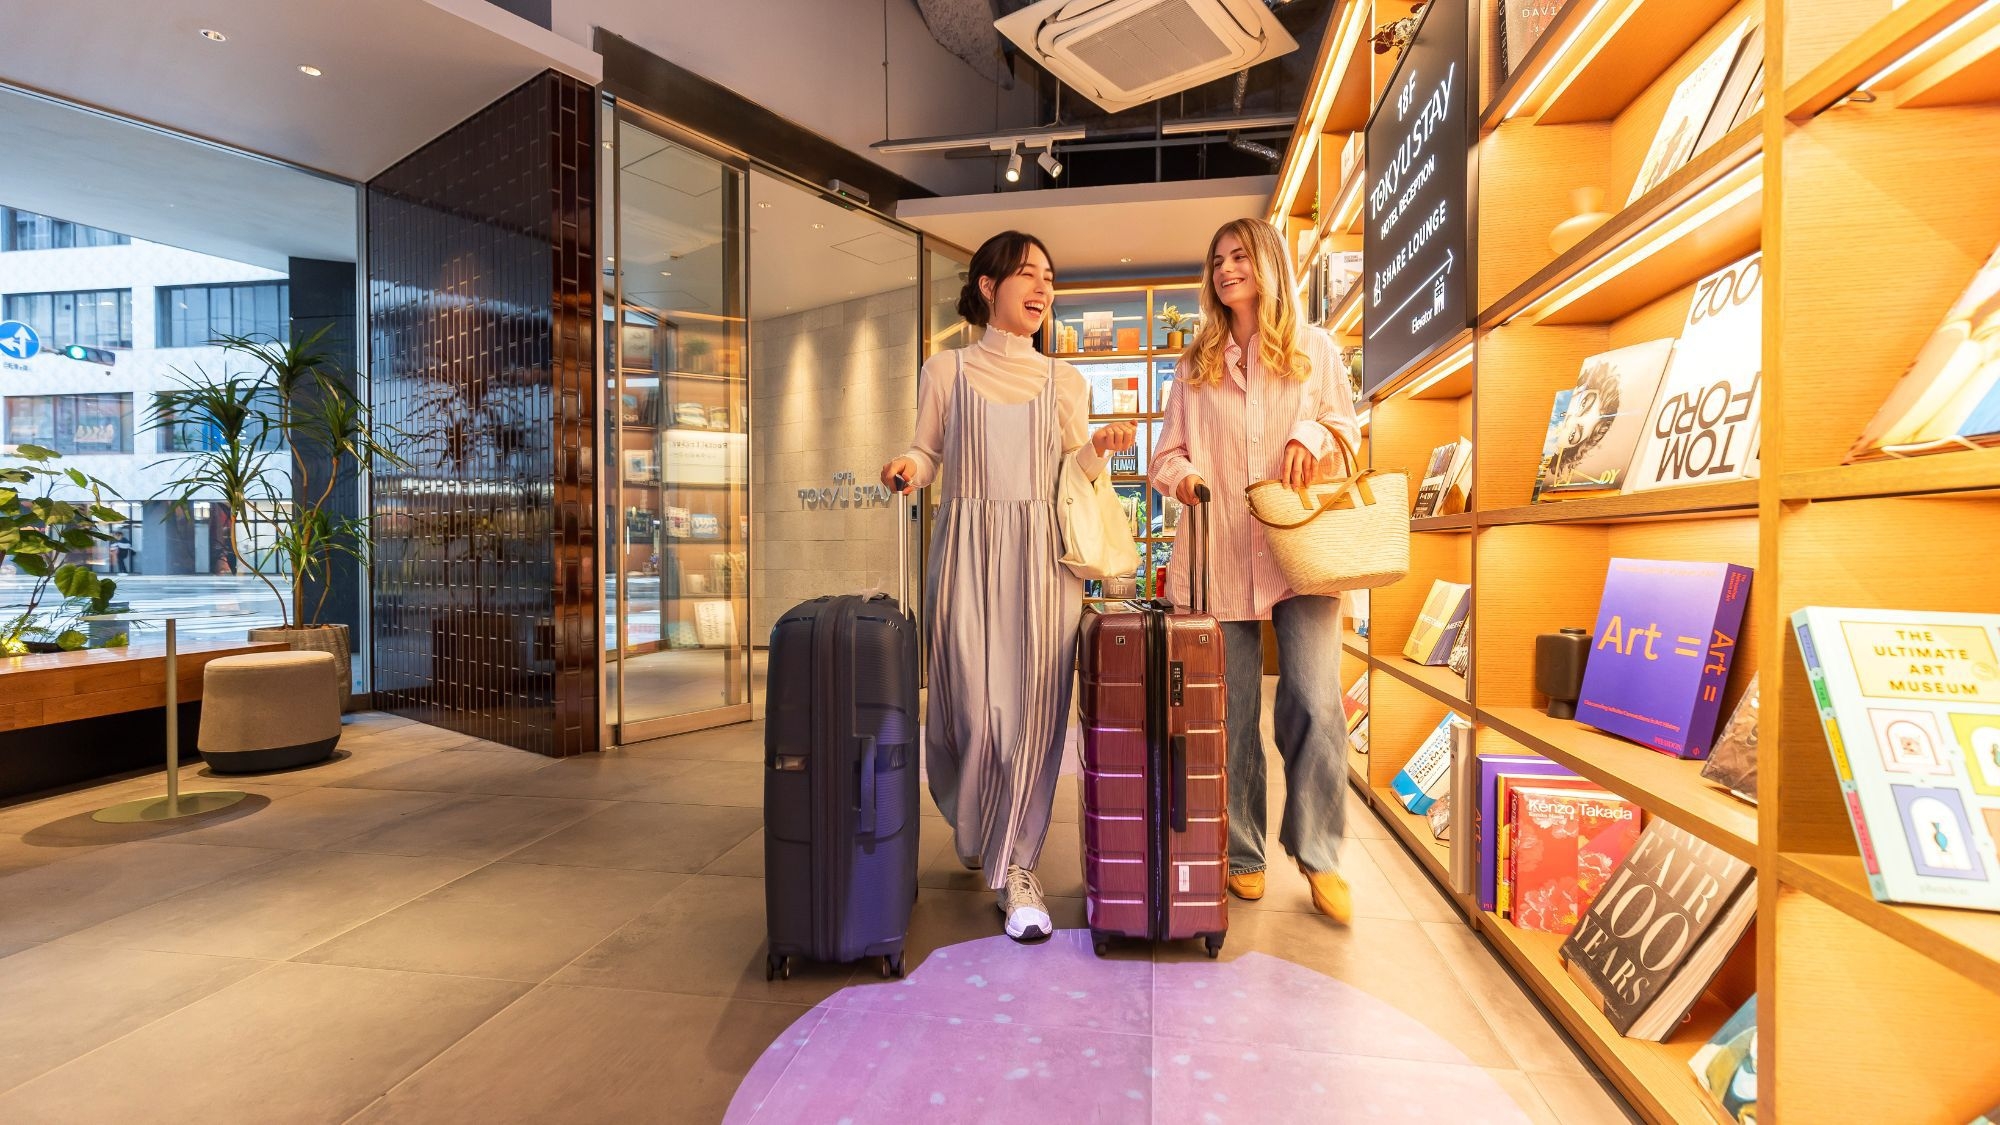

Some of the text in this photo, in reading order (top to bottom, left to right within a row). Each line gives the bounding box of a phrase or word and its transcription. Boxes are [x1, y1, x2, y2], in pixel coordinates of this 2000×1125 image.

[1522, 6, 1562, 18] DAVI
[1398, 70, 1416, 122] 18F
[1370, 62, 1455, 220] TOKYU STAY
[1381, 154, 1435, 240] HOTEL RECEPTION
[1382, 200, 1446, 289] SHARE LOUNGE
[1411, 307, 1434, 334] Elevator
[1655, 371, 1762, 439] FORD
[1113, 458, 1136, 471] HUMAN
[1656, 425, 1735, 482] TOM
[797, 484, 892, 508] TOKYU STAY
[1597, 615, 1701, 661] Art =
[1873, 645, 1969, 660] ULTIMATE
[1896, 630, 1934, 642] THE
[1703, 629, 1736, 702] Art =
[1890, 680, 1979, 695] MUSEUM
[1908, 664, 1946, 676] ART
[1528, 800, 1633, 820] Kenzo Takada
[1624, 831, 1719, 924] FAIR
[1592, 866, 1689, 972] 100
[1573, 912, 1650, 1006] YEARS
